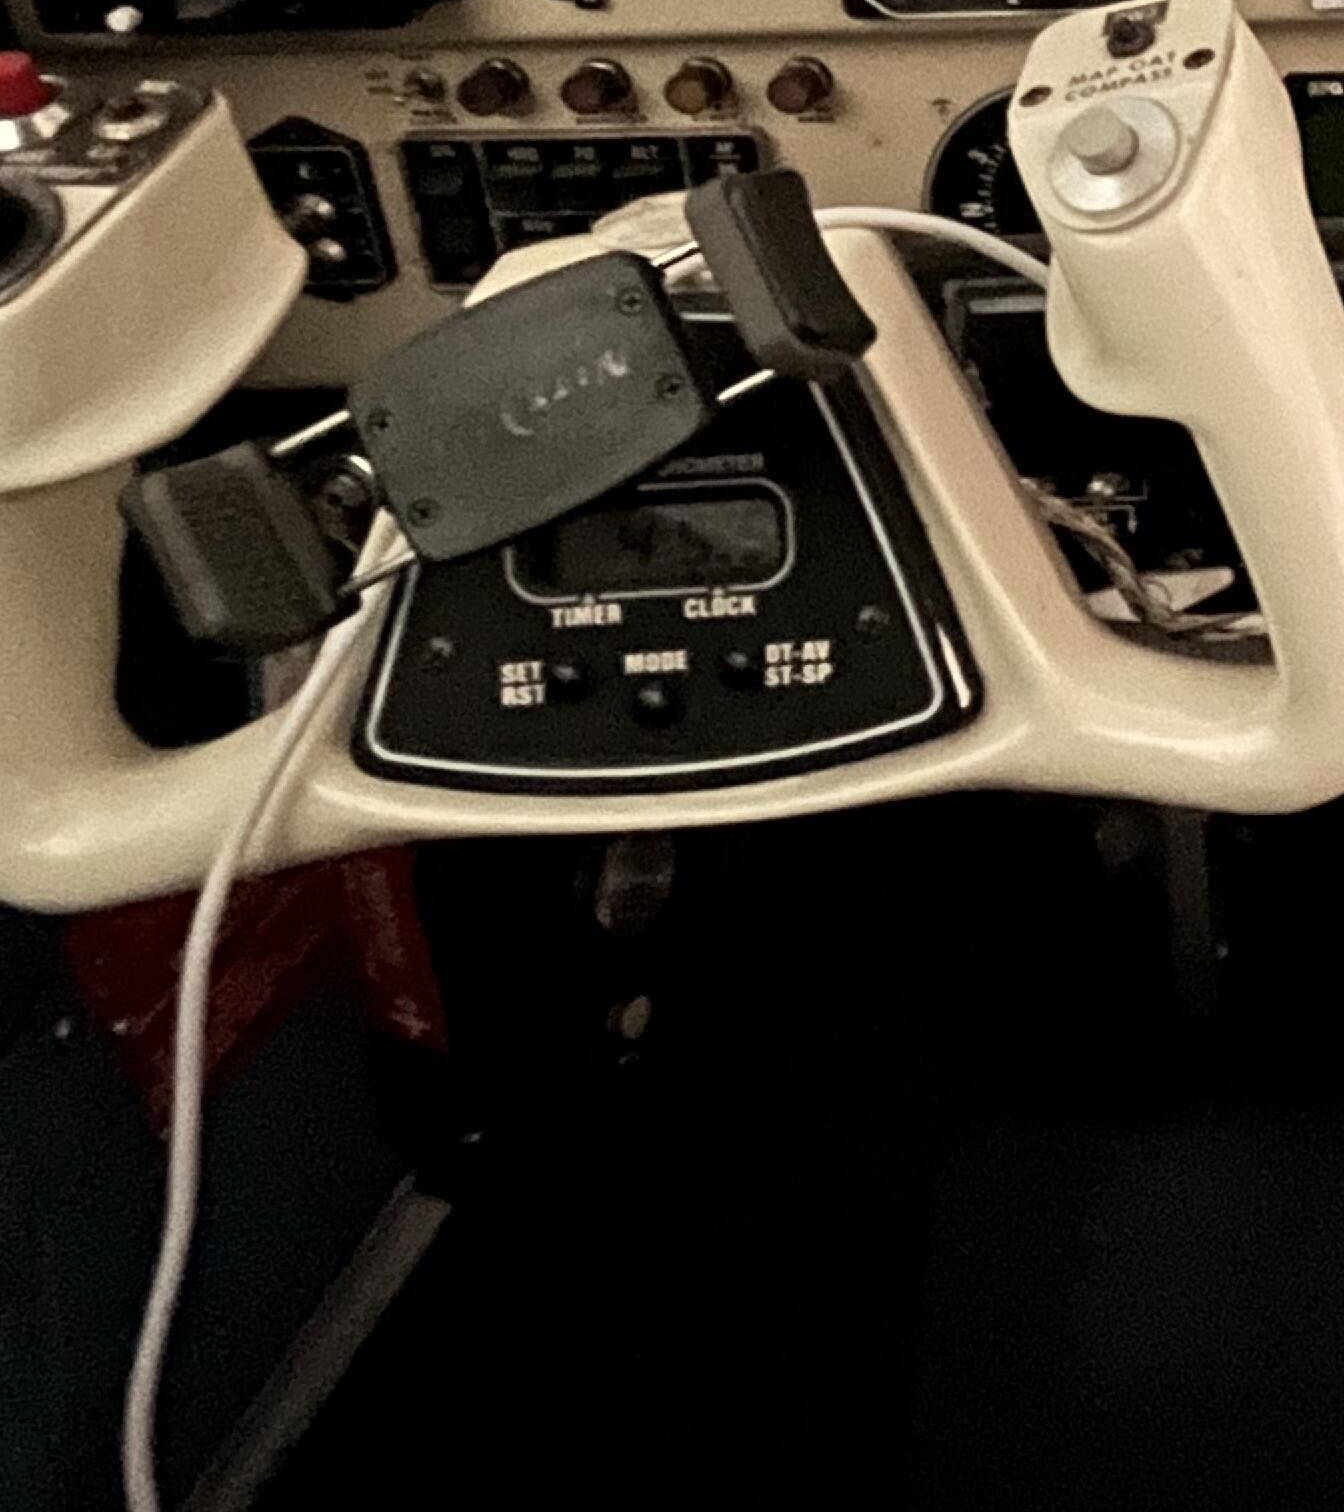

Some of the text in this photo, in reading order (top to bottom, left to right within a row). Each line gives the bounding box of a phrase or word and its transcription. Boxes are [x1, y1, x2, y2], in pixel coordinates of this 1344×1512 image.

[1068, 50, 1177, 88] MAP OAT
[1064, 68, 1173, 103] COMPASS
[550, 603, 623, 629] TIMER
[683, 595, 757, 620] CLOCK
[623, 649, 689, 675] MODE
[764, 640, 831, 664] DT-AV
[500, 660, 545, 684] SET
[764, 662, 834, 687] ST-SP
[500, 682, 546, 707] RST
